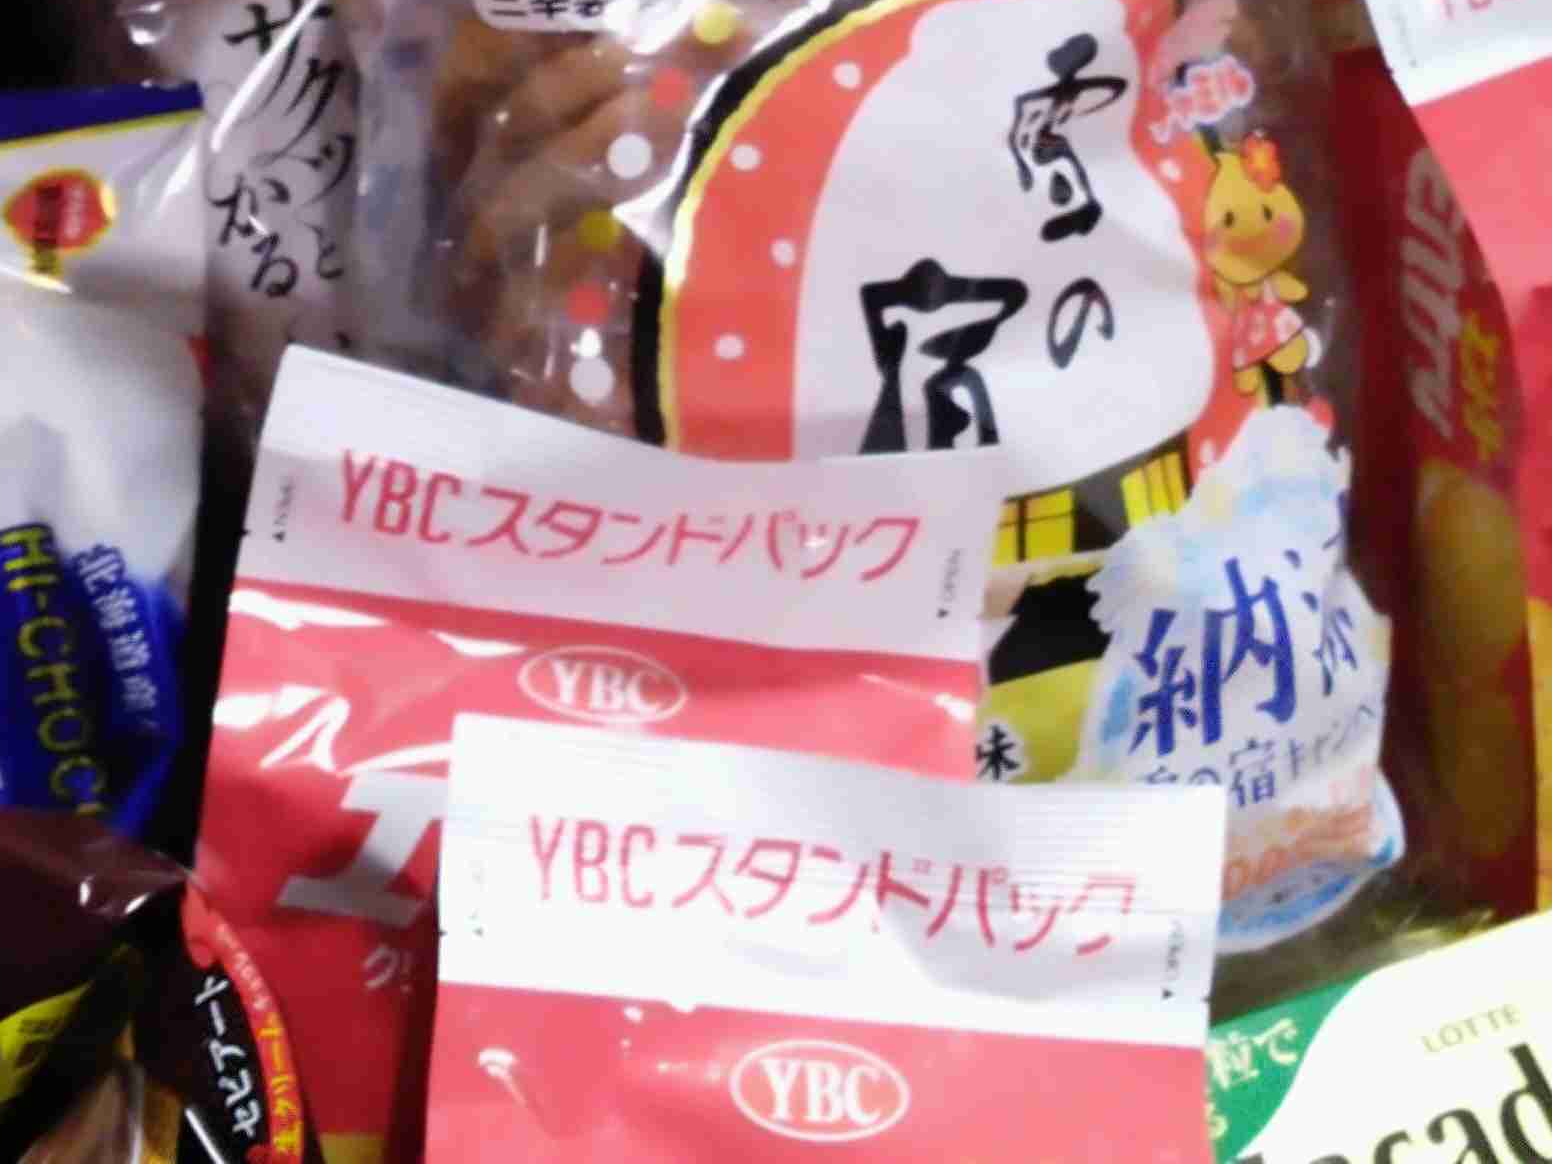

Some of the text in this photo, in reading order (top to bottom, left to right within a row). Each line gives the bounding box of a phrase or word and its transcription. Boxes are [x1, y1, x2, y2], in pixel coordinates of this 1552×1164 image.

[338, 447, 923, 585] YBCスタンドパック
[548, 652, 668, 716] YBC
[529, 814, 1139, 957] YBCスタンドパック
[1420, 1003, 1523, 1053] LOTTE
[765, 1060, 882, 1128] YBC
